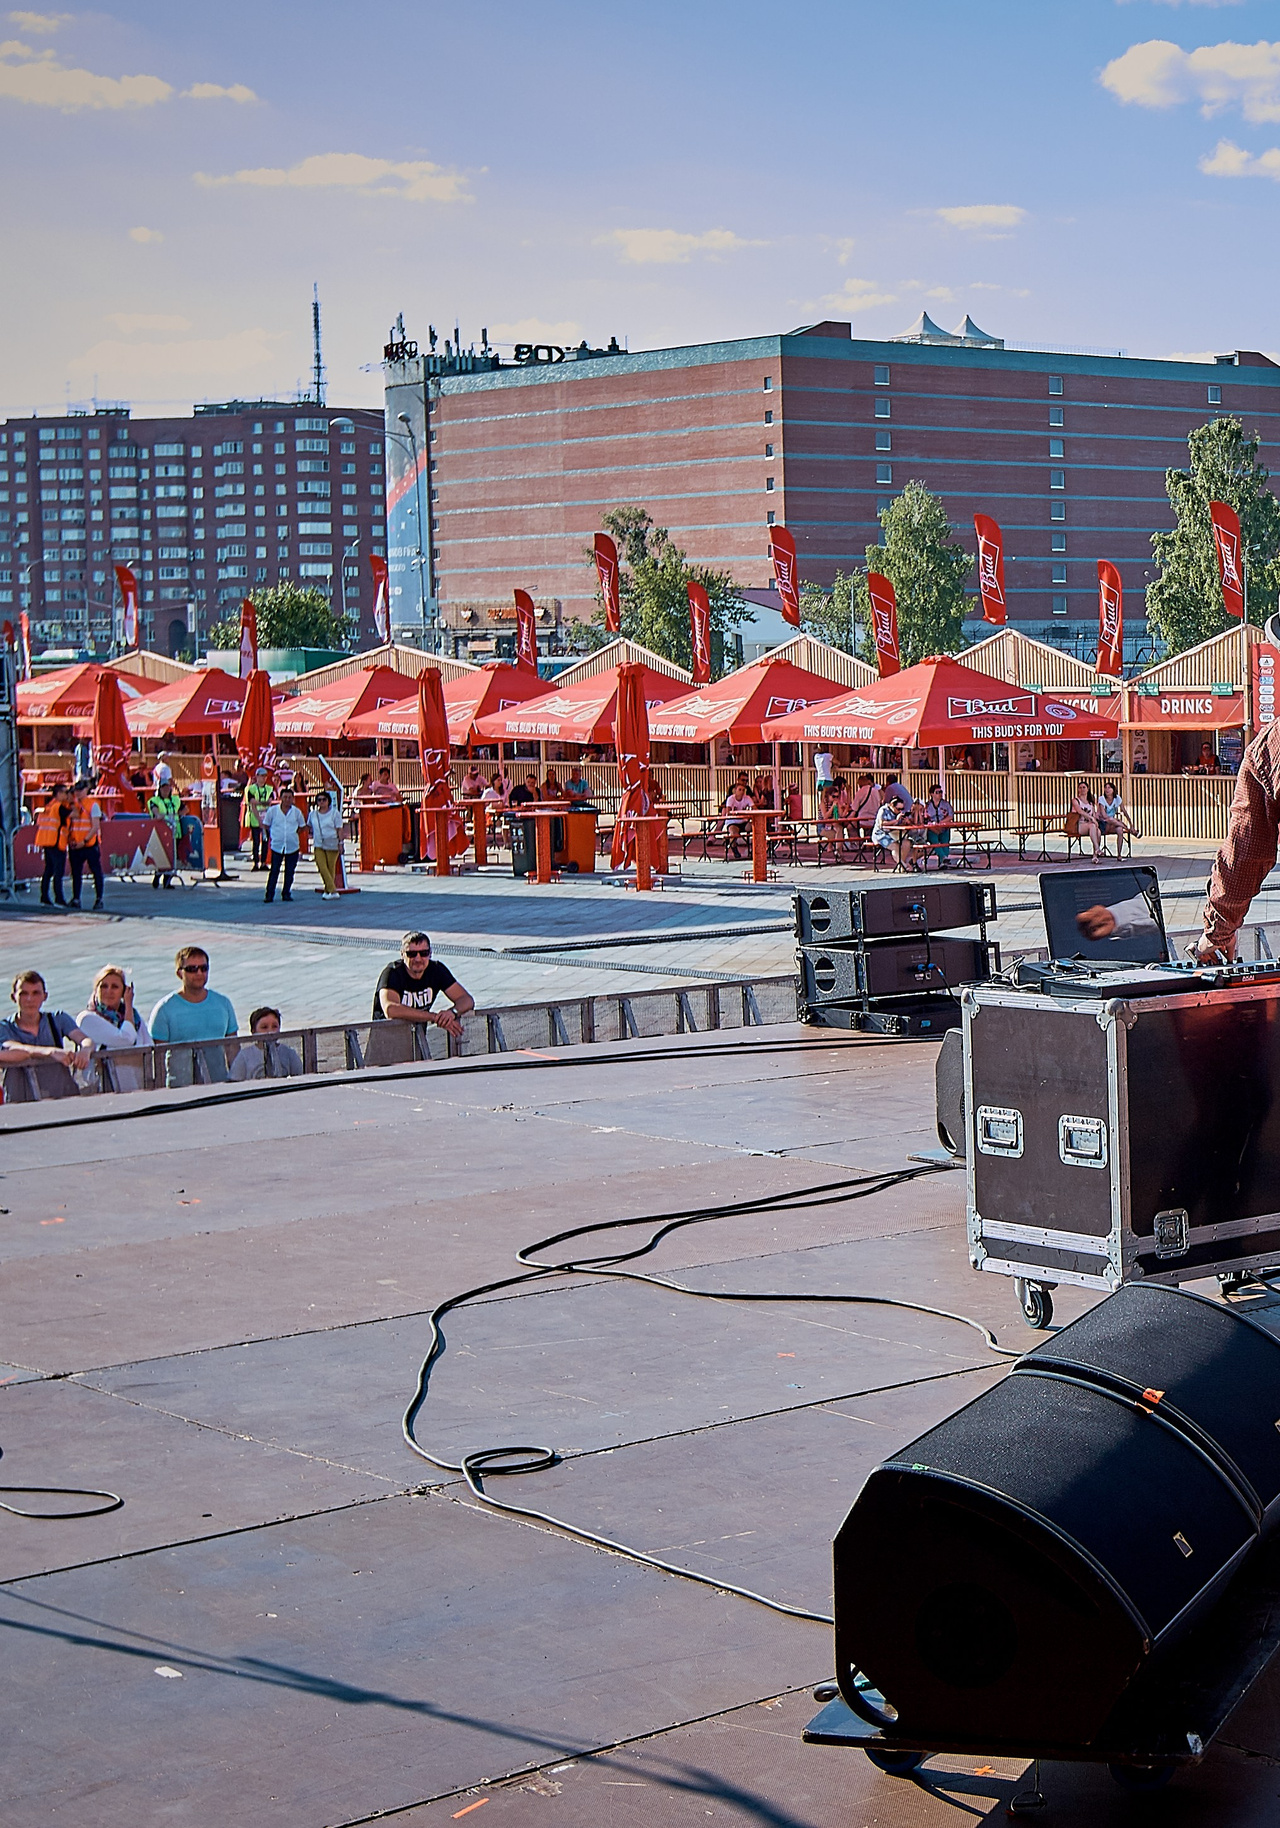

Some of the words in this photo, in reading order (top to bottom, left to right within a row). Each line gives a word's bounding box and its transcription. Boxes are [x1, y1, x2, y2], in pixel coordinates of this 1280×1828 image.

[776, 560, 792, 598] Bud
[981, 552, 997, 593] Bud
[1221, 542, 1238, 585] Bud
[876, 609, 893, 648] Bud
[1103, 599, 1117, 640] Bud
[952, 699, 1018, 714] Bud
[1161, 699, 1213, 714] DRINKS
[803, 724, 820, 737] THIS
[820, 725, 843, 739] BUD'S
[843, 726, 859, 739] FOR
[858, 727, 875, 740] YOU
[971, 726, 993, 739] THIS
[994, 724, 1023, 738] BUD'S
[1024, 724, 1043, 736] FOR
[1044, 723, 1064, 735] YOU
